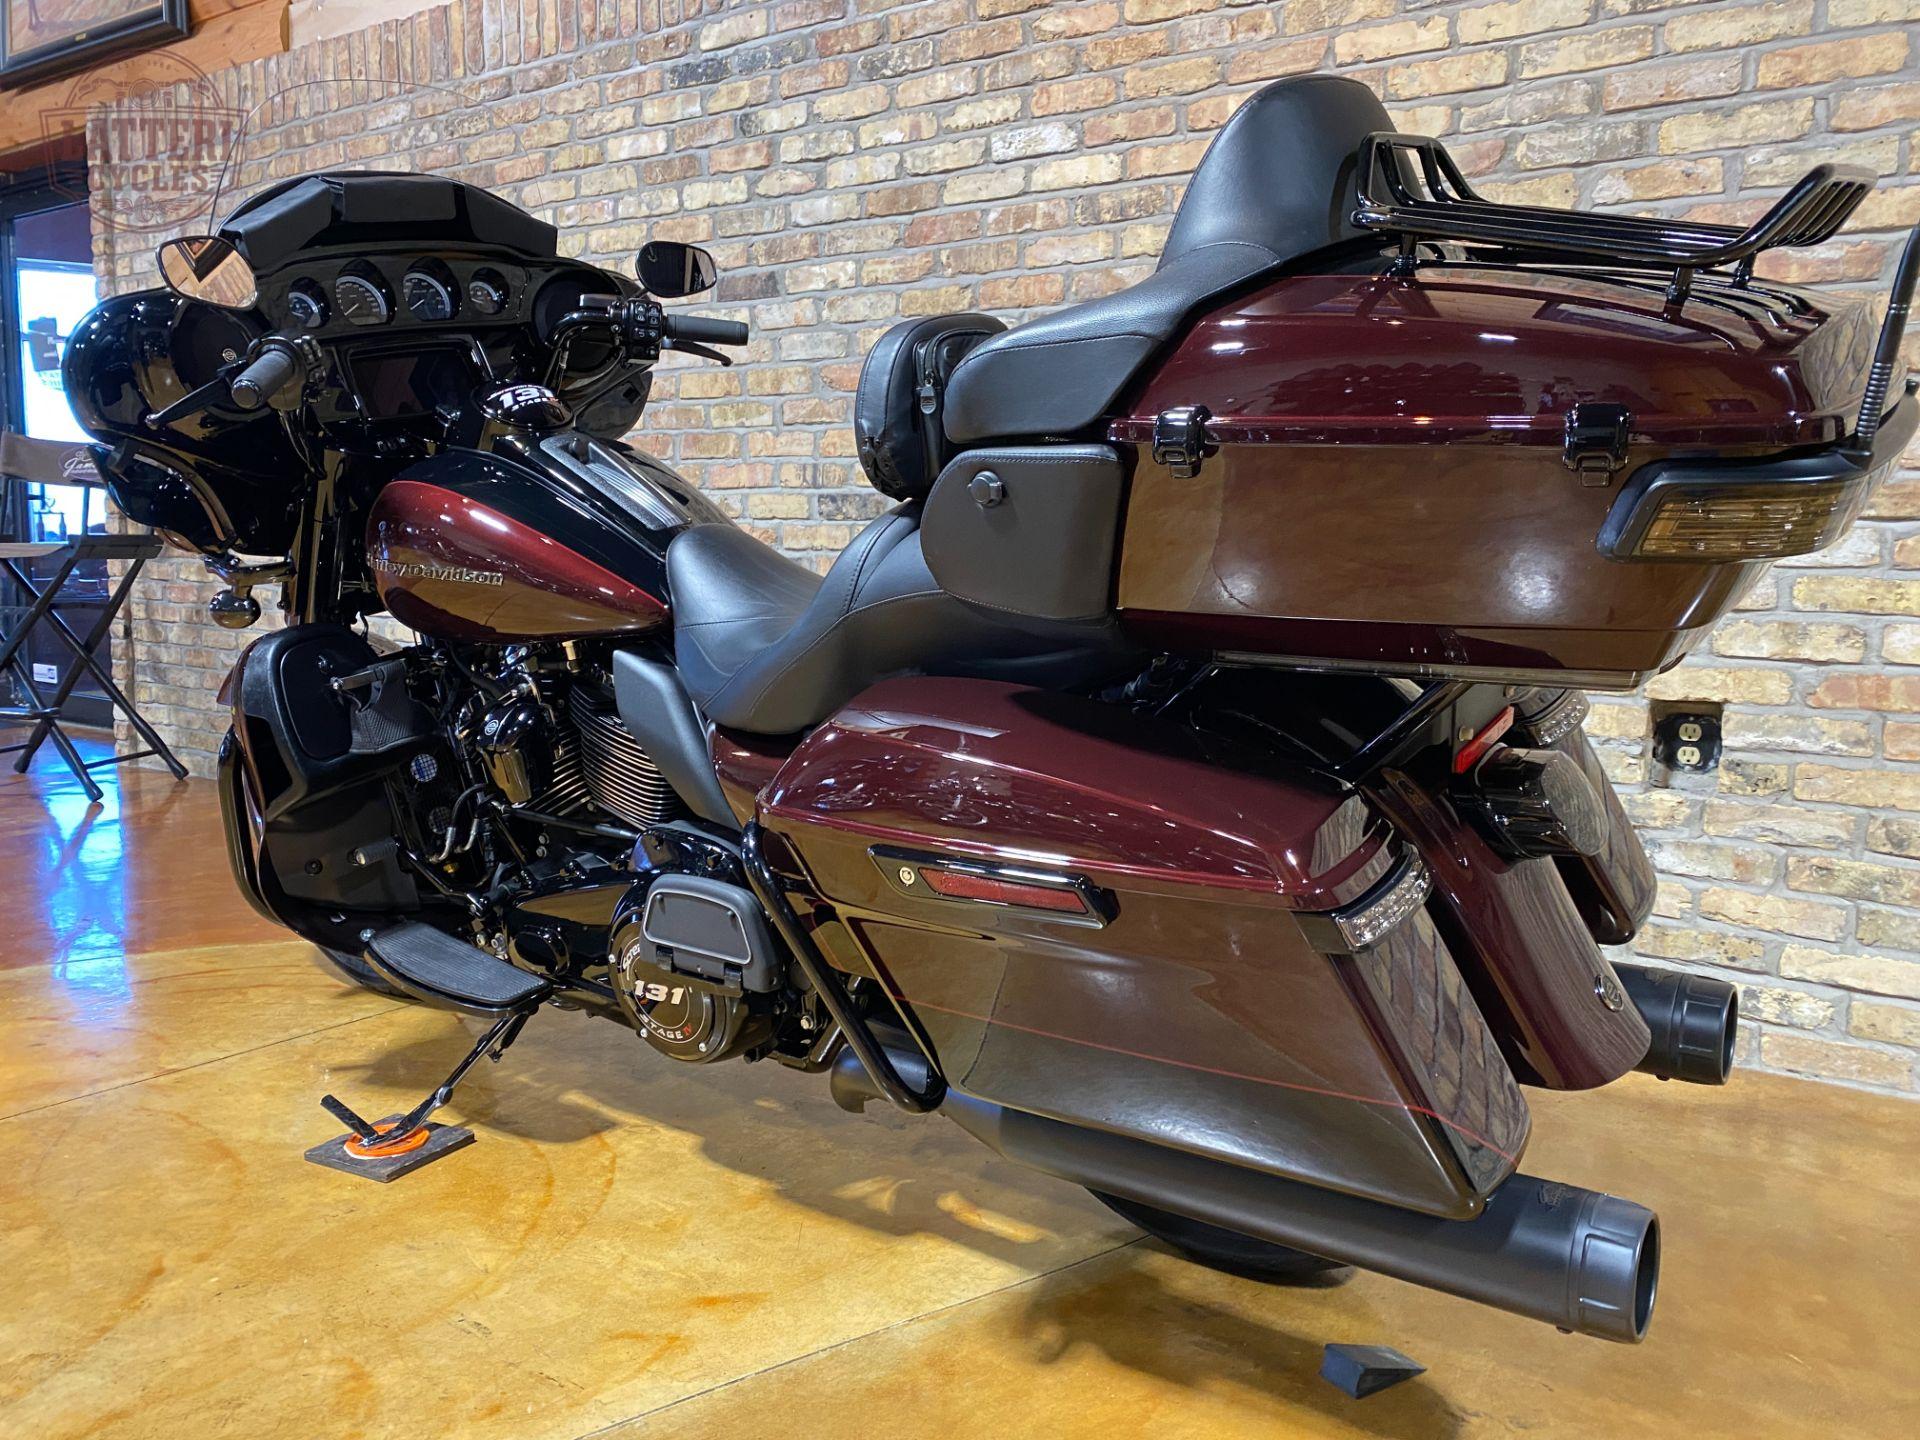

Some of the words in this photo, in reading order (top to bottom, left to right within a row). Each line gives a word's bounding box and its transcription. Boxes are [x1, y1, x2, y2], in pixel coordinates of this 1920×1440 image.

[499, 388, 554, 408] 131
[511, 397, 549, 412] STAGE
[635, 980, 684, 1005] 131
[639, 1013, 684, 1040] STAGE
